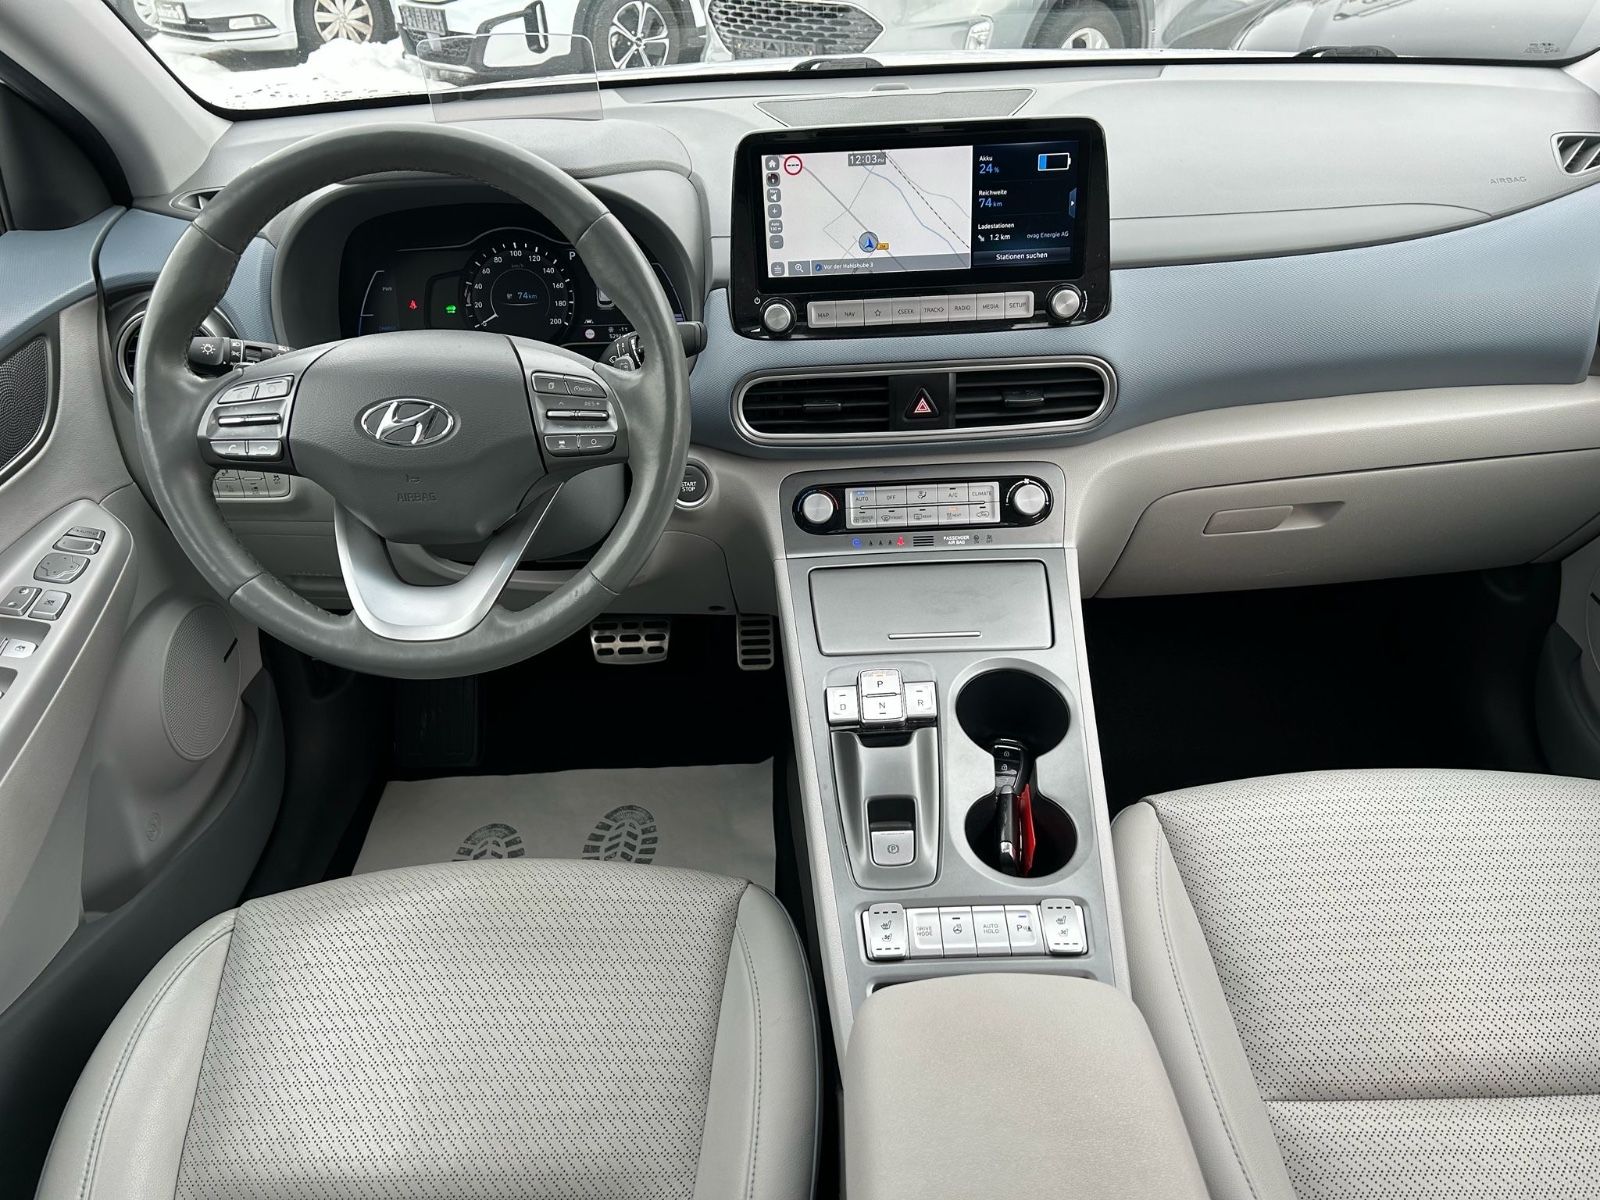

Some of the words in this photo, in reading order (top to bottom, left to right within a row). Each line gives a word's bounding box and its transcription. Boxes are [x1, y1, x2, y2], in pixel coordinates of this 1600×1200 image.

[849, 154, 877, 165] 12:03
[1488, 176, 1527, 184] AIRBAG
[978, 198, 992, 208] 74
[977, 222, 1015, 230] Ladestationen
[1040, 231, 1060, 239] Energie
[569, 251, 576, 260] P
[995, 253, 1025, 261] Stationen
[396, 492, 438, 502] AIRBAG
